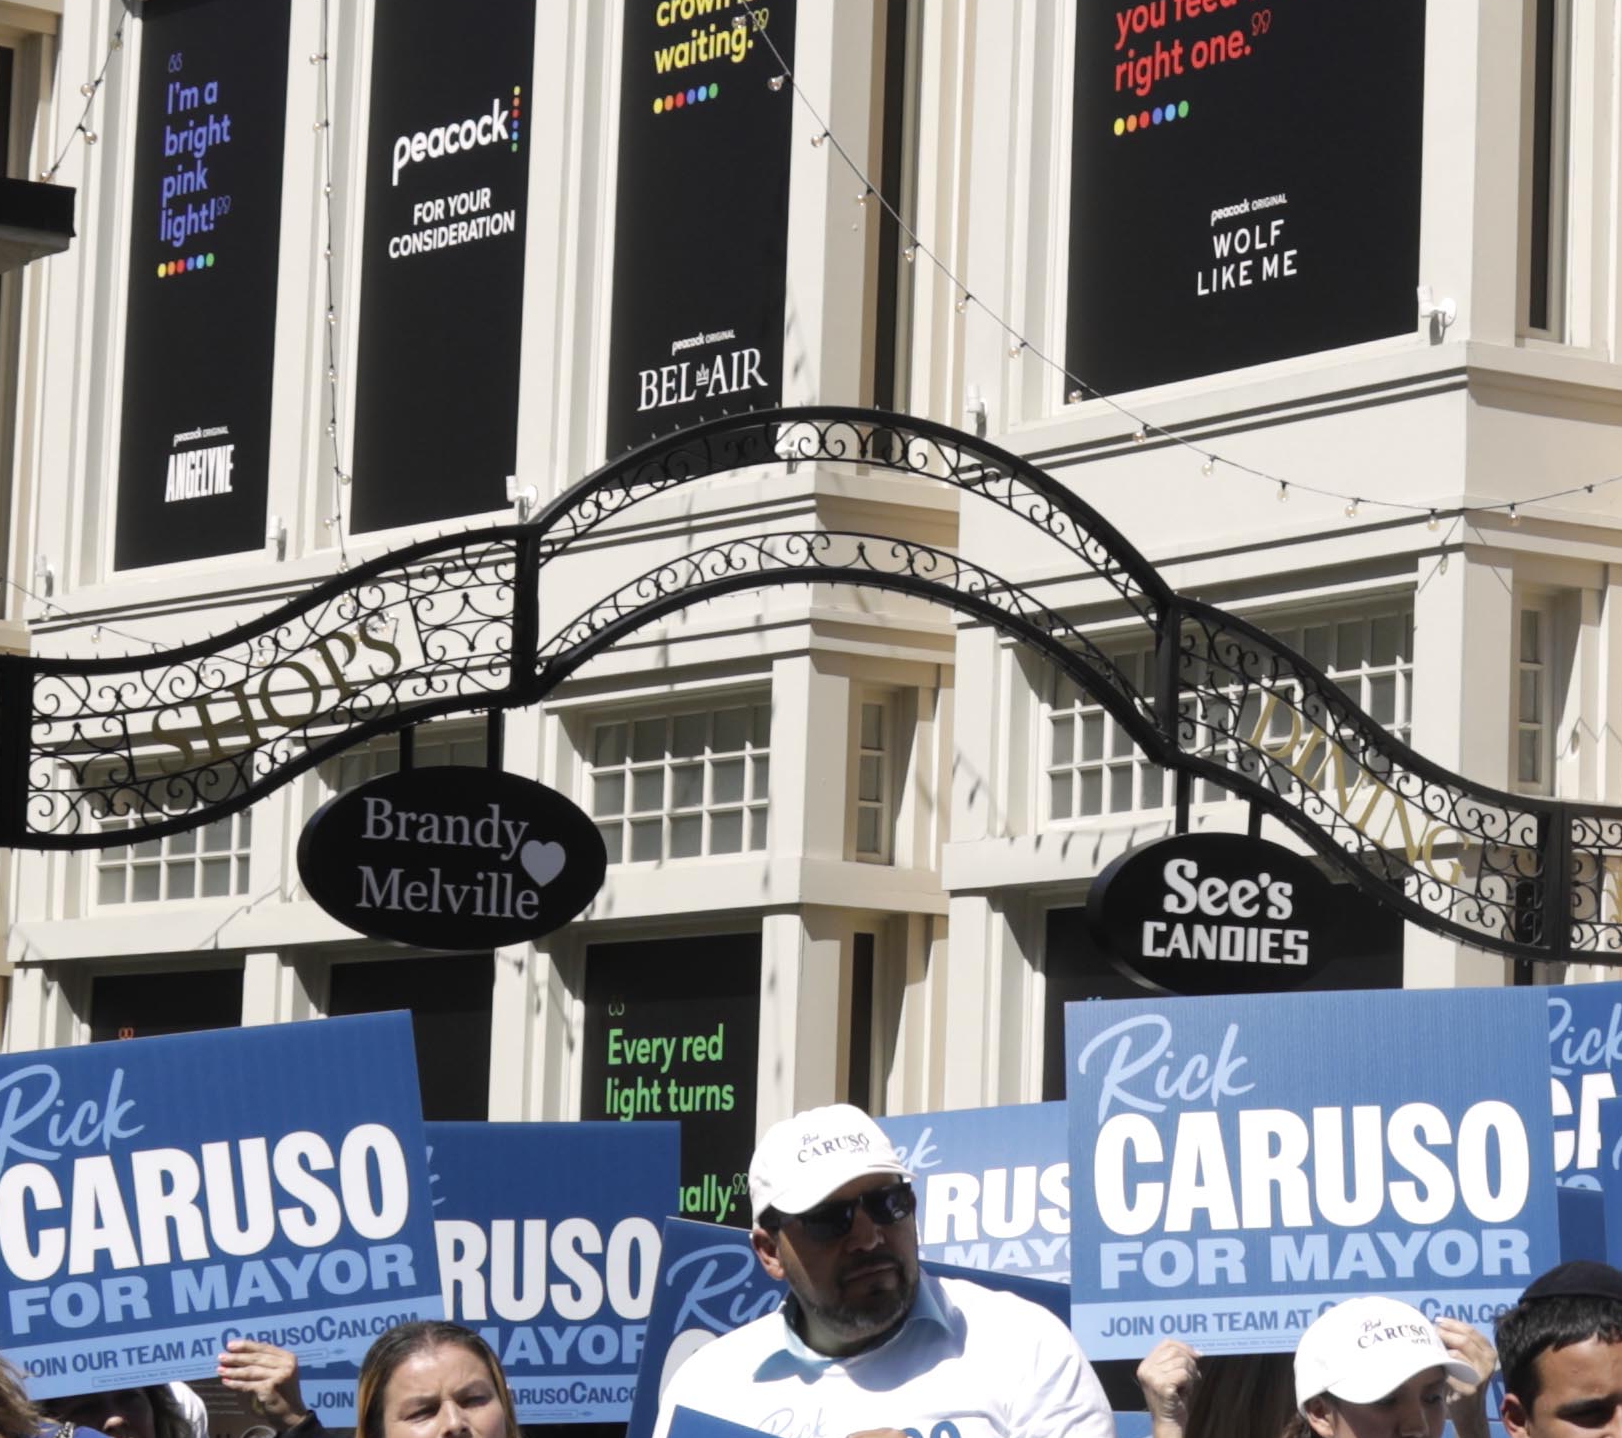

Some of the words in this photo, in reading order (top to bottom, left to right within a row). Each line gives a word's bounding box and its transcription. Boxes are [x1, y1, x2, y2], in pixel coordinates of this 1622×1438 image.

[1115, 4, 1166, 51] you
[1115, 40, 1183, 96] right
[167, 83, 198, 114] I'm
[204, 81, 219, 105] a
[164, 115, 231, 159] bright
[392, 100, 508, 185] peacock
[162, 162, 209, 207] pink
[413, 195, 449, 226] FOR
[449, 188, 492, 219] YOUR
[389, 209, 515, 259] CONSIDERATION
[1211, 199, 1249, 227] peacock
[1252, 194, 1287, 210] ORIGINAL
[1213, 220, 1285, 259] WOLF
[1197, 258, 1253, 296] LIKE
[1262, 250, 1298, 281] ME
[637, 362, 697, 411] BEL
[706, 348, 768, 397] AIR
[165, 444, 234, 502] ANGELYNE
[149, 621, 403, 770] SHOPS
[1252, 692, 1470, 887] DINING
[362, 797, 530, 861] Brandy
[356, 865, 540, 920] Melville
[1161, 857, 1293, 922] See's
[1142, 922, 1309, 966] CANDIES
[607, 1029, 674, 1068] Every
[682, 1024, 724, 1061] red
[1078, 1013, 1256, 1124] Rick
[606, 1078, 662, 1121] light
[668, 1080, 734, 1112] turns
[1093, 1100, 1530, 1234] CARUSO
